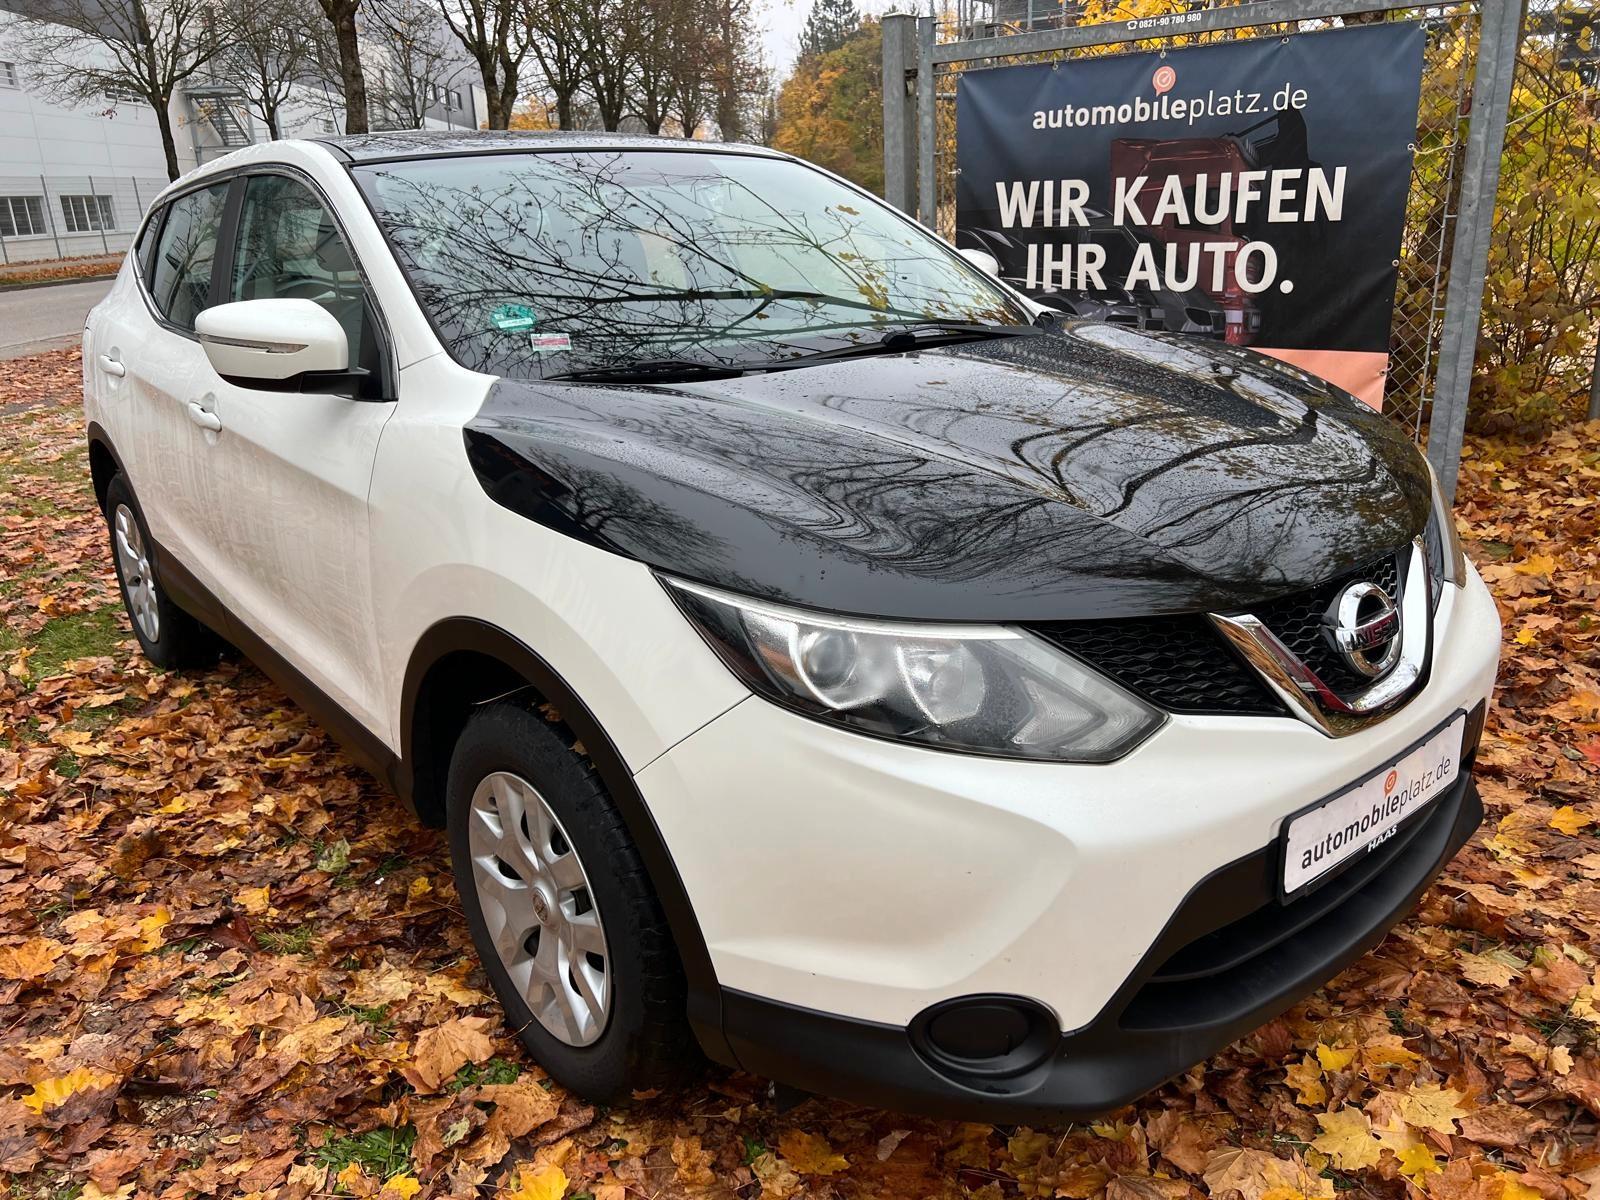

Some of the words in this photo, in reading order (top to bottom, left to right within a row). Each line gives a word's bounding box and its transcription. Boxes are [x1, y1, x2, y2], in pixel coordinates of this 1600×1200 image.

[1138, 17, 1169, 28] 0821-90
[1171, 15, 1185, 25] 780
[1187, 12, 1202, 22] 980
[1032, 82, 1308, 130] automobileplatz.de
[995, 179, 1091, 228] WIR
[1112, 166, 1347, 226] KAUFEN
[1026, 243, 1108, 291] IHR
[1123, 240, 1294, 295] AUTO.
[1301, 756, 1451, 869] automobileplatz.de
[1367, 825, 1398, 853] HAAS
